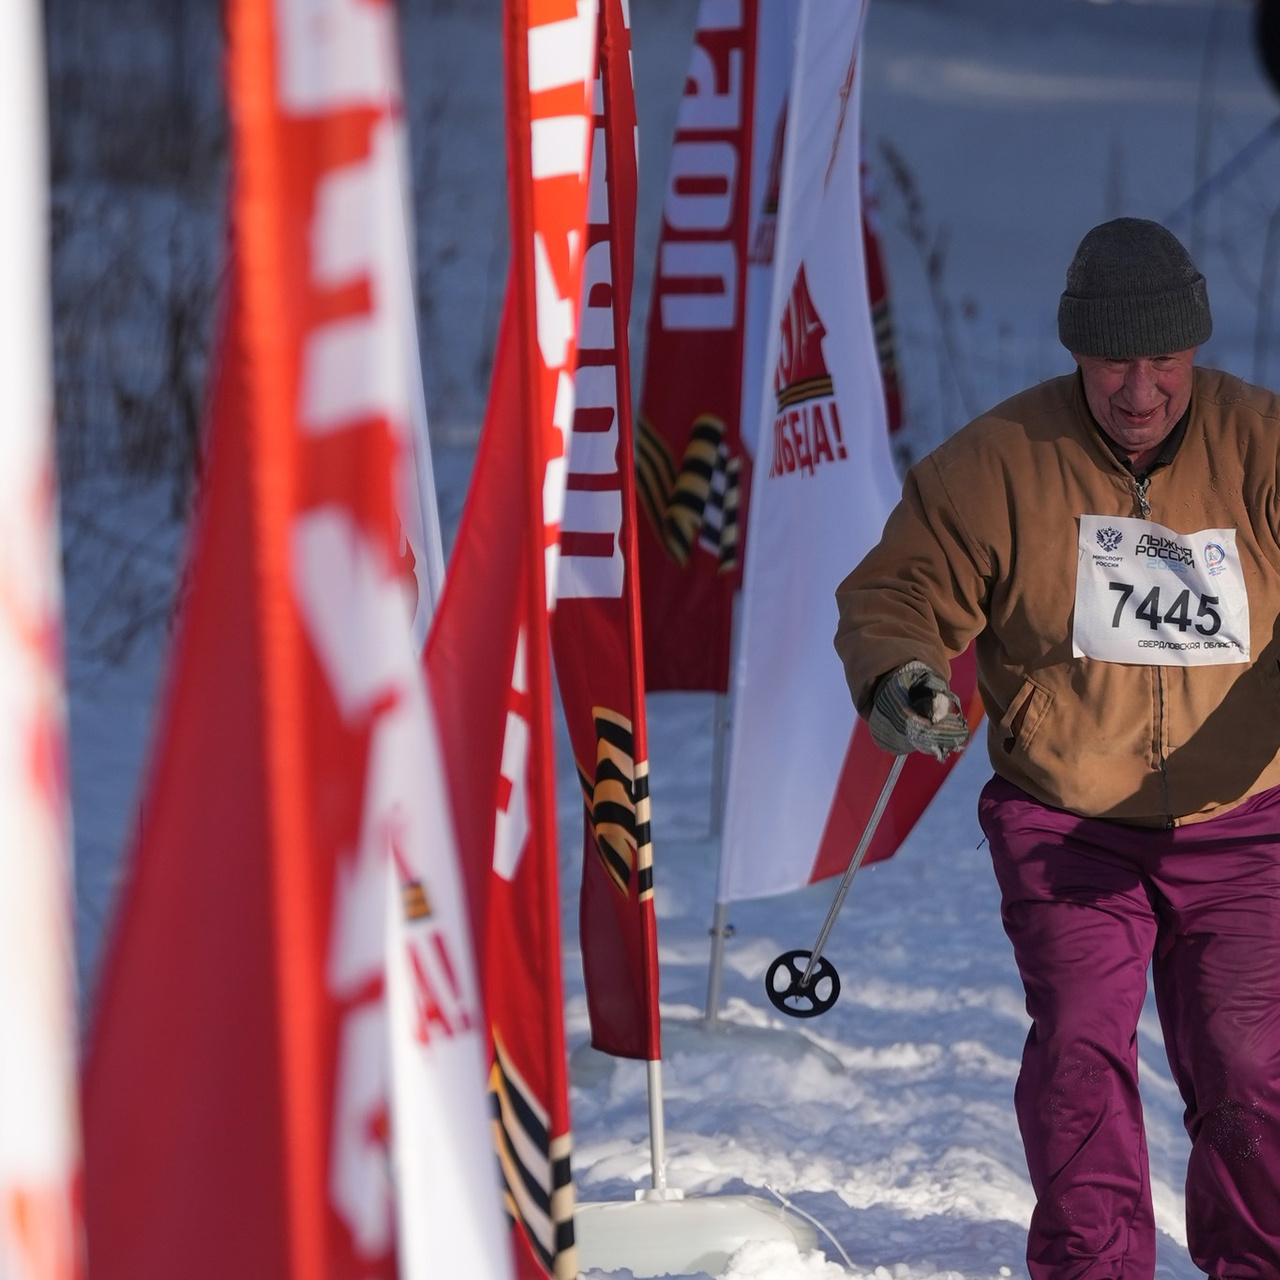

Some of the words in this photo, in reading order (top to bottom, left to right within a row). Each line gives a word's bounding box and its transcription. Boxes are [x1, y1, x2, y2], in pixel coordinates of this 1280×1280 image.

[1135, 545, 1195, 569] РОССИИ
[1139, 534, 1192, 558] ЛЫЖНЯ
[1108, 581, 1222, 636] 7445
[1137, 639, 1201, 651] СВЕРДЛОВСКАЯ
